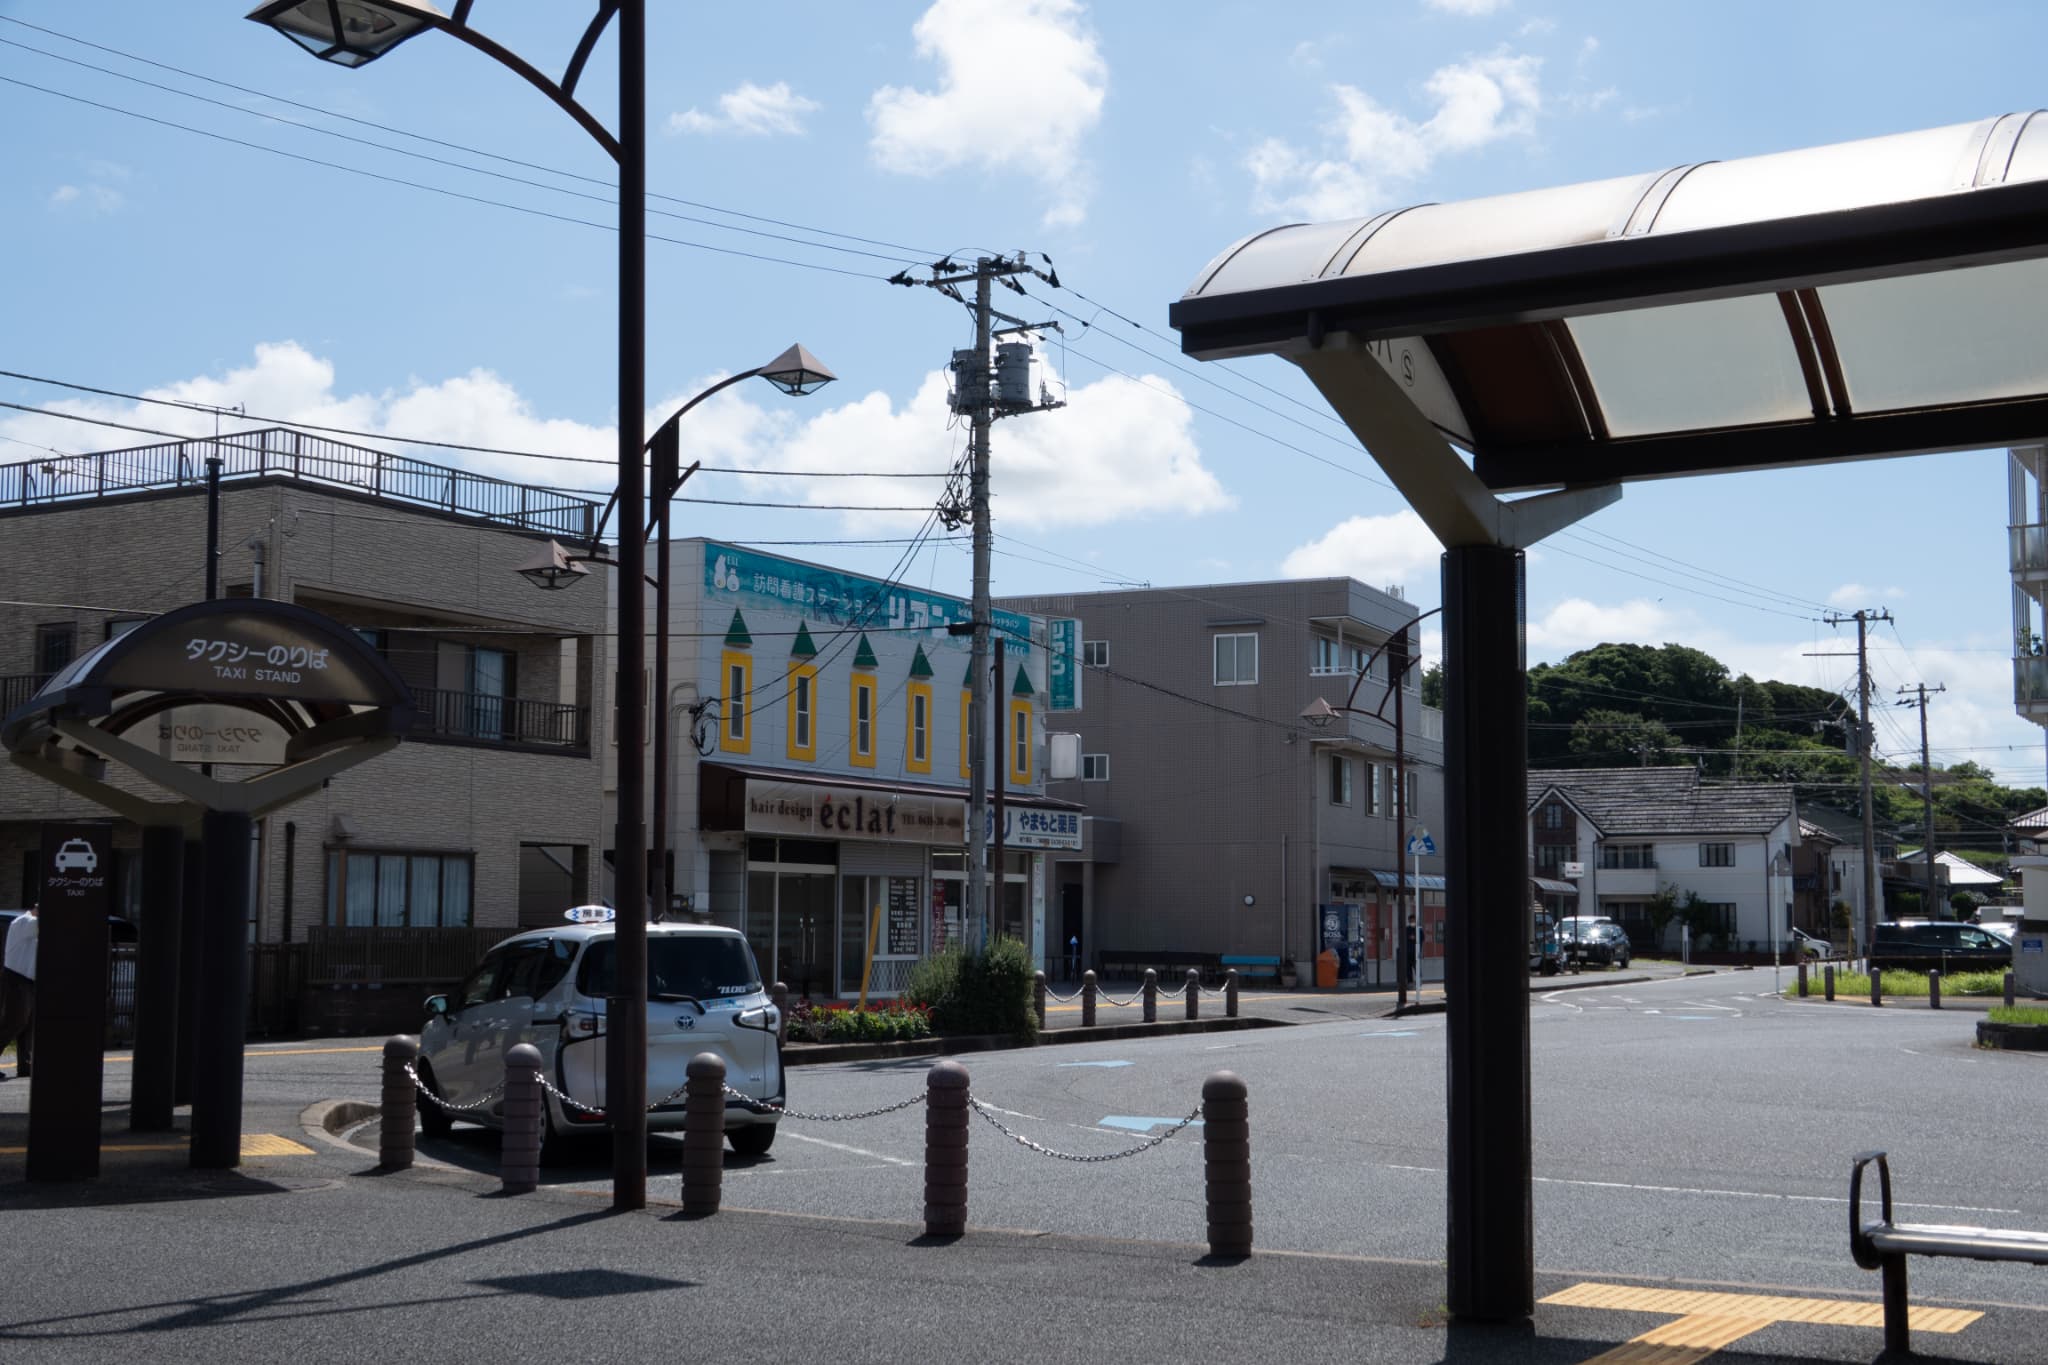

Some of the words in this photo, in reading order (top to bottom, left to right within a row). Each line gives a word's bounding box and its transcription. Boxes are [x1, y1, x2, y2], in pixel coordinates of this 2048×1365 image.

[185, 638, 329, 670] タクシーのりば
[213, 665, 246, 680] TAXI
[255, 669, 301, 684] STAND
[750, 797, 775, 815] hair
[778, 800, 813, 822] design
[819, 793, 896, 834] éclat
[1019, 811, 1078, 834] やまもと薬局
[47, 876, 105, 888] タクシーのりば
[66, 889, 85, 897] TAXI
